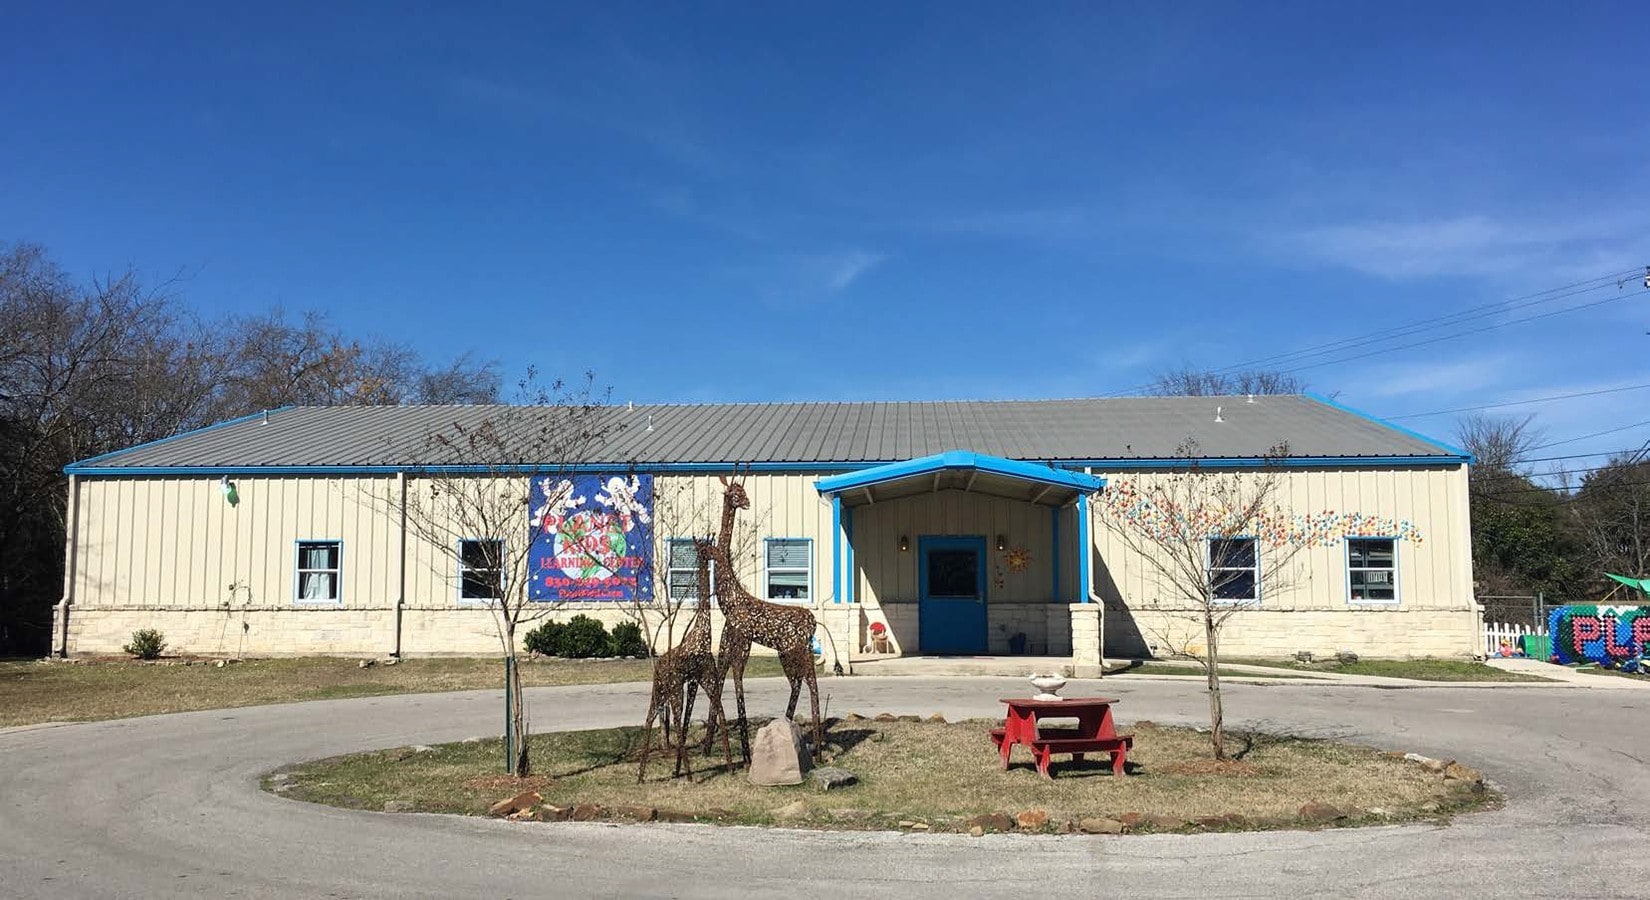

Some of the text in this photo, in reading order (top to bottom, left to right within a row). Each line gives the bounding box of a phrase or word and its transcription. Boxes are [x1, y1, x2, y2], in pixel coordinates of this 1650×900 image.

[543, 514, 631, 534] PLANET
[562, 535, 611, 555] KIDS
[540, 556, 644, 569] LEARNING CENTER
